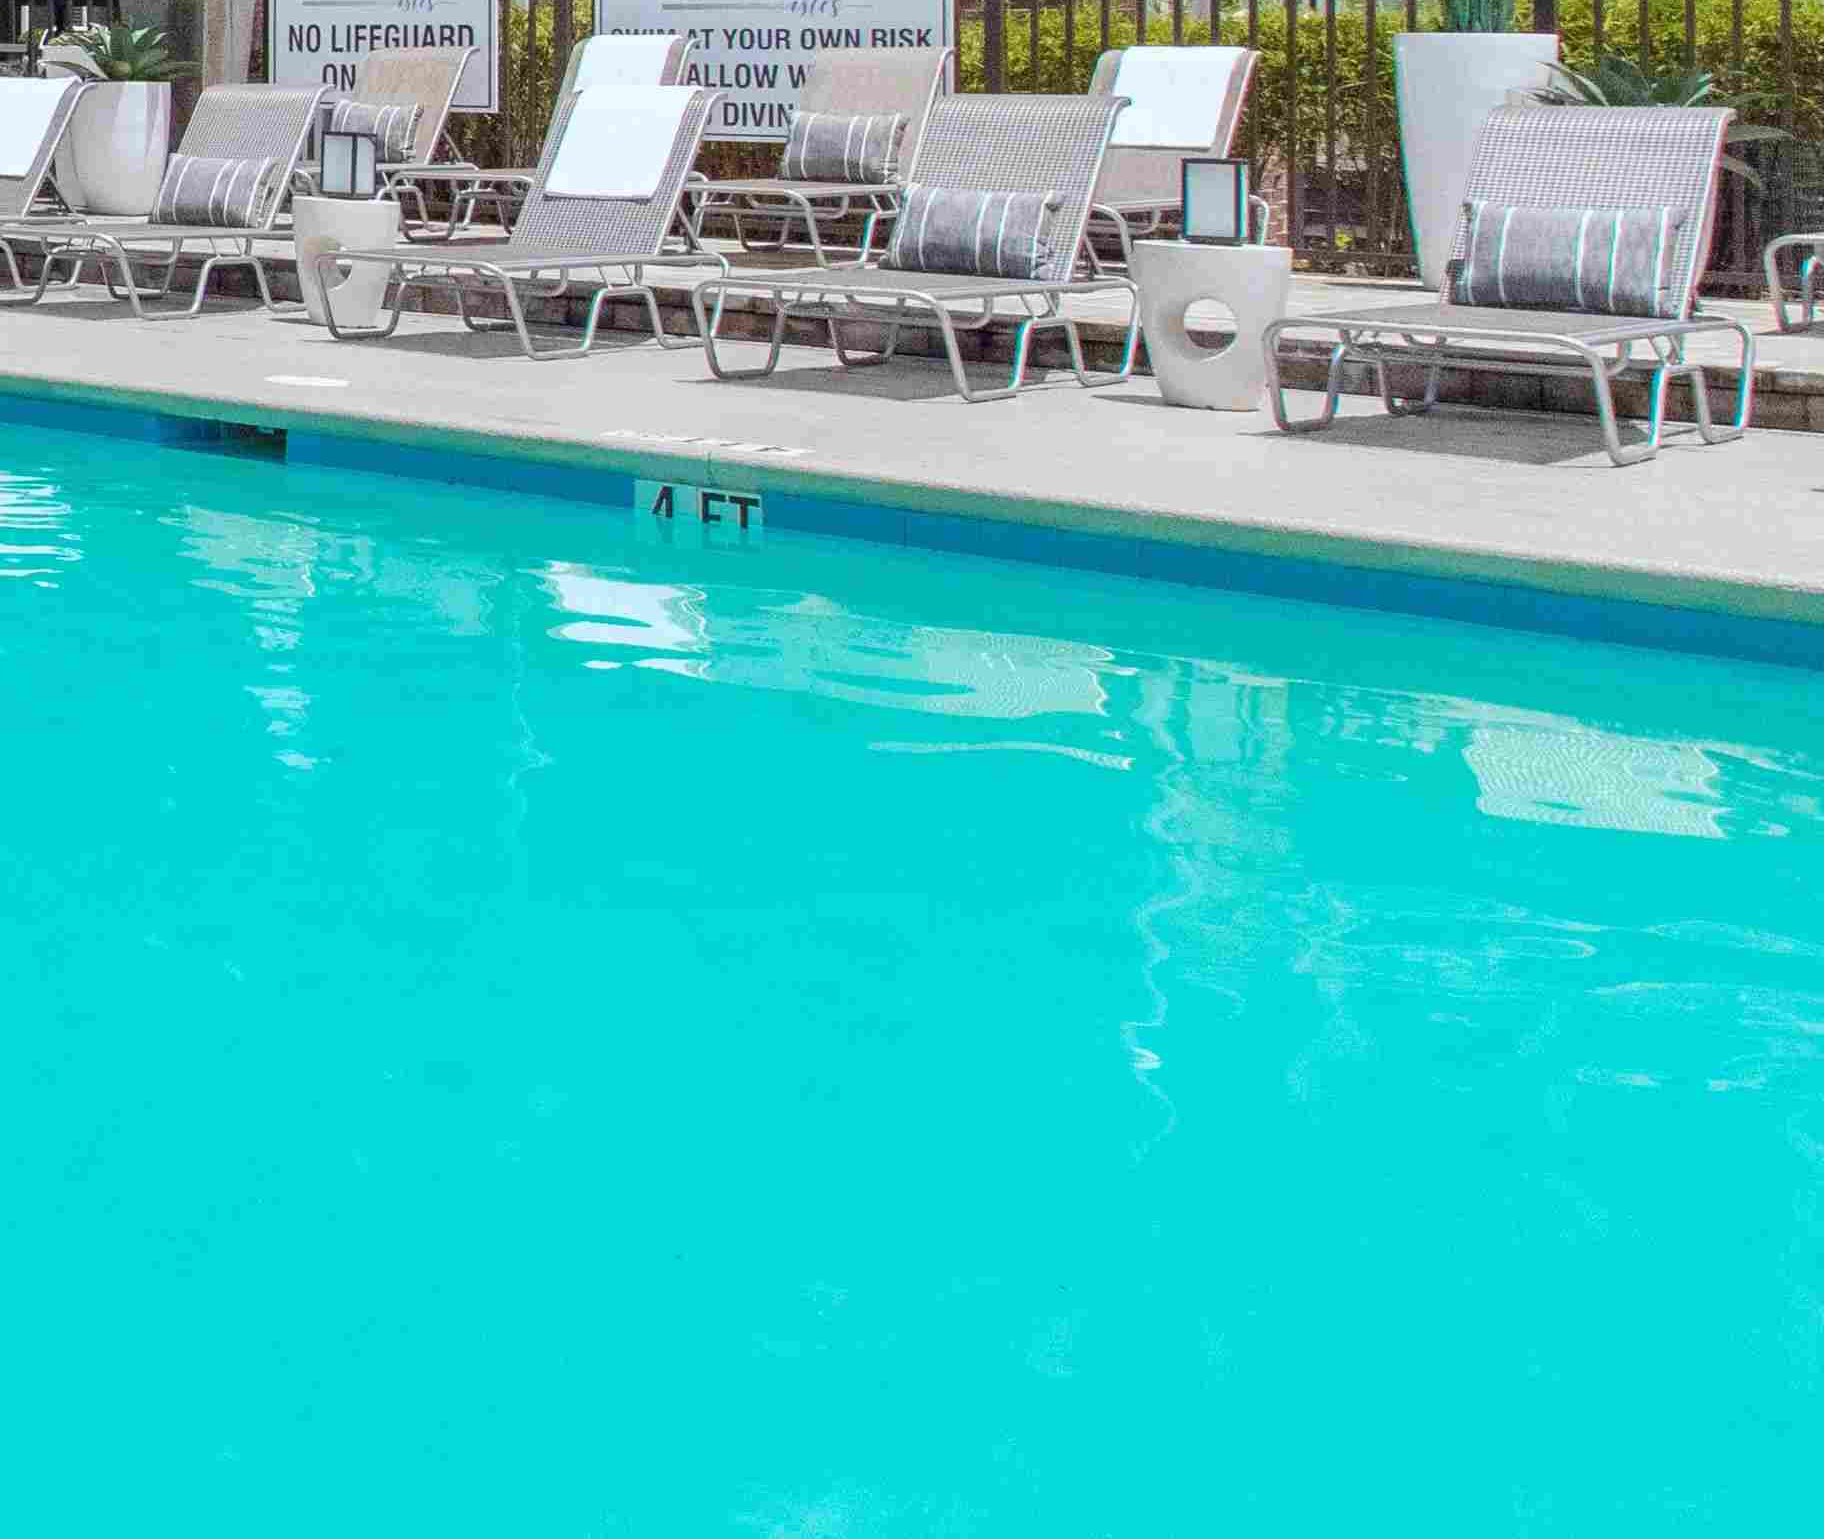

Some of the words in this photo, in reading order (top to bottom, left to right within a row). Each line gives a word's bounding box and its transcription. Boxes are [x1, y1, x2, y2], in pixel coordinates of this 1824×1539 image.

[288, 24, 321, 53] NO
[330, 23, 475, 53] LIFEGUARD
[688, 28, 715, 50] AT
[722, 27, 791, 50] YOUR
[800, 27, 861, 50] OWN
[871, 27, 933, 48] RISK
[322, 63, 357, 92] ON
[687, 62, 779, 89] ALLOW
[722, 101, 794, 128] DIVIN
